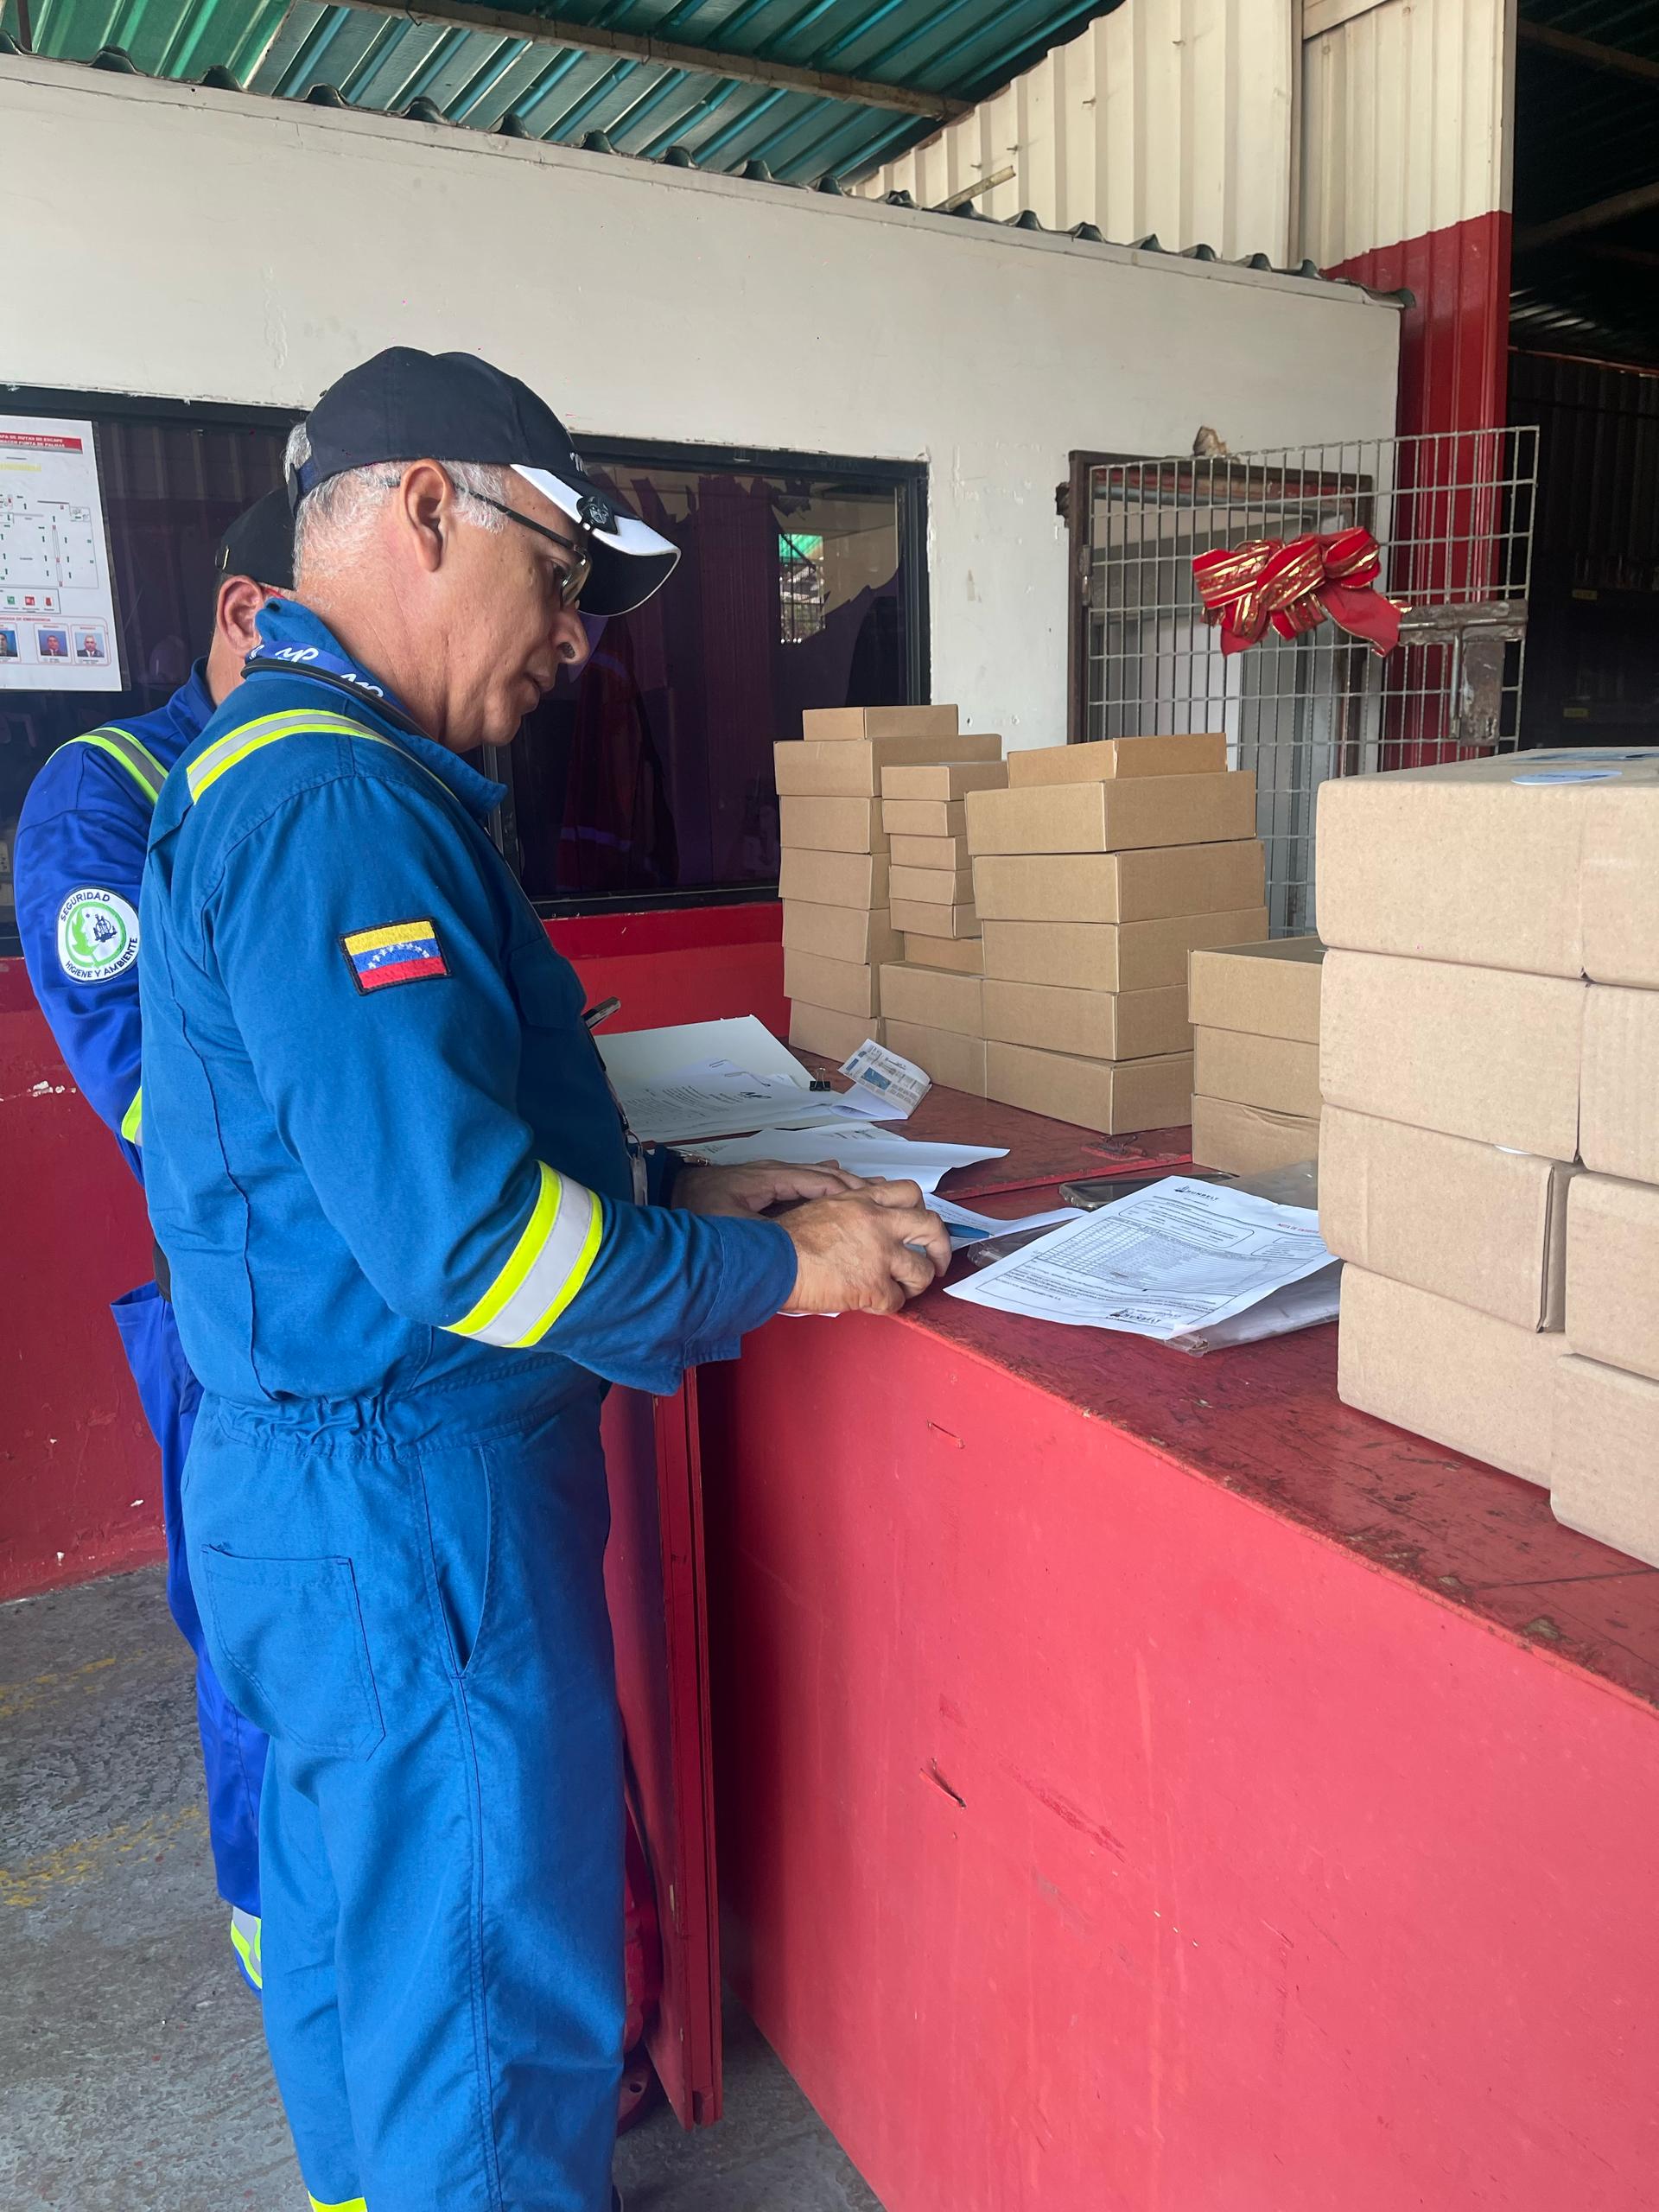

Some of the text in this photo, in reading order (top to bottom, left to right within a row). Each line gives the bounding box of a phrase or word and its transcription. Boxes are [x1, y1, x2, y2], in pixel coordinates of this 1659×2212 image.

[60, 892, 111, 922] SEGURIDAD
[65, 937, 138, 978] HIGIENE Y AMBIENTE
